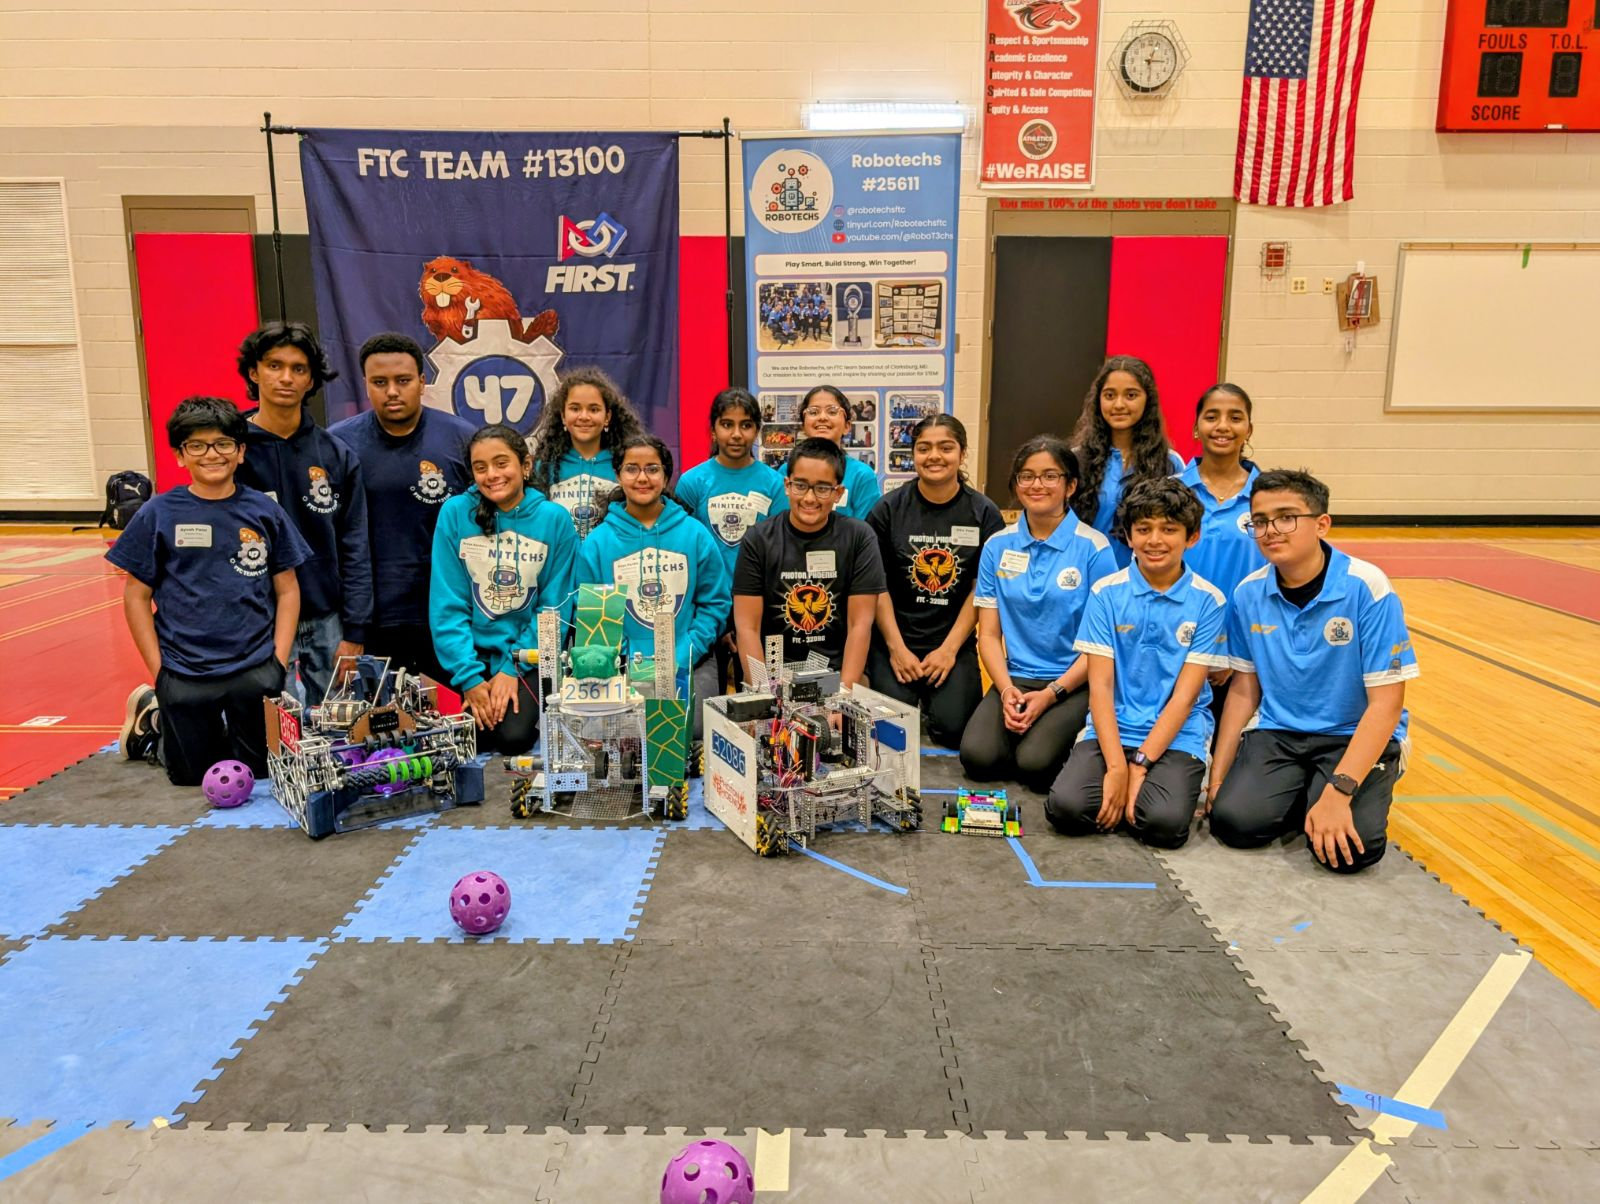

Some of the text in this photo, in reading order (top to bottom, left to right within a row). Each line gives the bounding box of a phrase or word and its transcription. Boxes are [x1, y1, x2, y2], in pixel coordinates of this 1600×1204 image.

[989, 33, 1088, 46] Respect & Sportsmanship
[1478, 34, 1528, 49] FOULS
[1550, 34, 1588, 49] T.O.L.
[988, 50, 1068, 62] Academic Excellence
[990, 67, 1072, 81] Integrity & Character
[987, 86, 1092, 99] Spirited & Safe Competition
[986, 102, 1048, 115] Equity & Access
[1471, 105, 1521, 120] SCORE
[357, 146, 625, 180] FTC TEAM #13100
[852, 152, 942, 168] Robotechs
[986, 163, 1086, 180] #WeRAISE
[862, 176, 920, 192] #25611
[765, 212, 820, 222] ROBOTECHS
[847, 204, 906, 216] @robotechsftc
[884, 259, 917, 267] Together!
[545, 263, 636, 293] FIRST
[463, 374, 535, 425] 47
[552, 490, 594, 498] MINITE
[488, 549, 544, 562] NITECHS
[643, 562, 684, 574] ITECHS
[565, 683, 624, 700] 25611
[713, 730, 746, 774] 32086
